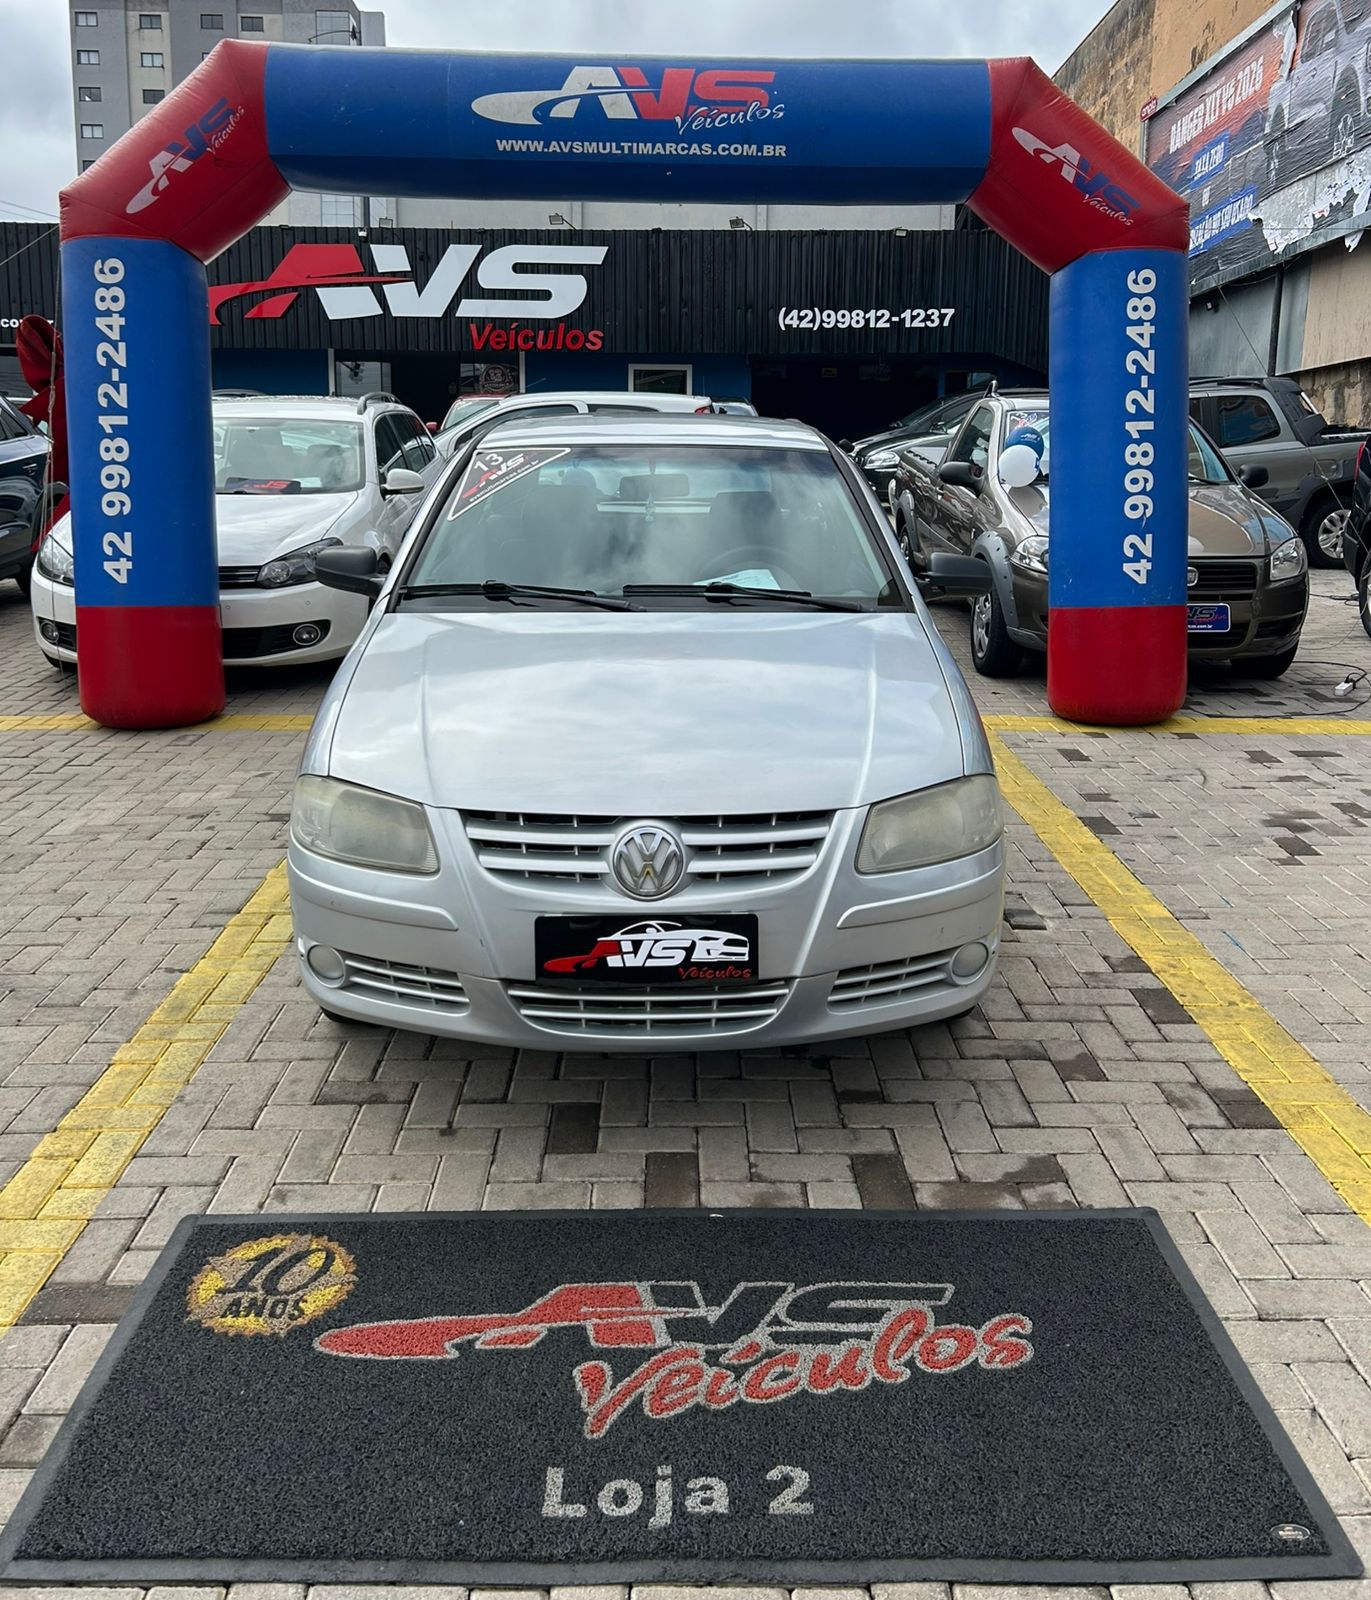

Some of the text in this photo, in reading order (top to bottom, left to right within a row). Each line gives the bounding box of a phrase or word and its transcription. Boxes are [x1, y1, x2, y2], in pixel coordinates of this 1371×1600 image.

[471, 65, 776, 125] AVS
[674, 101, 786, 135] Veículos
[206, 105, 245, 154] Veículos
[496, 139, 787, 158] WWW.AVSMULTIMARCAS.COM.BR
[126, 96, 235, 214] AVS
[1012, 127, 1142, 215] AVS
[1083, 194, 1134, 226] Veículos
[208, 243, 609, 326] AVS
[469, 322, 604, 351] Veículos
[778, 307, 956, 331] (42)99812-1237
[94, 258, 134, 585] 42 99812-2486
[1122, 268, 1157, 584] 42 99812-2486
[474, 453, 503, 471] 13
[543, 939, 693, 973] AVS
[678, 965, 752, 981] Veículos
[215, 1247, 336, 1297] 10
[220, 1296, 308, 1321] ANOS
[313, 1280, 955, 1361] AVS
[573, 1303, 1034, 1439] Veículos
[541, 1465, 815, 1530] Loja 2
